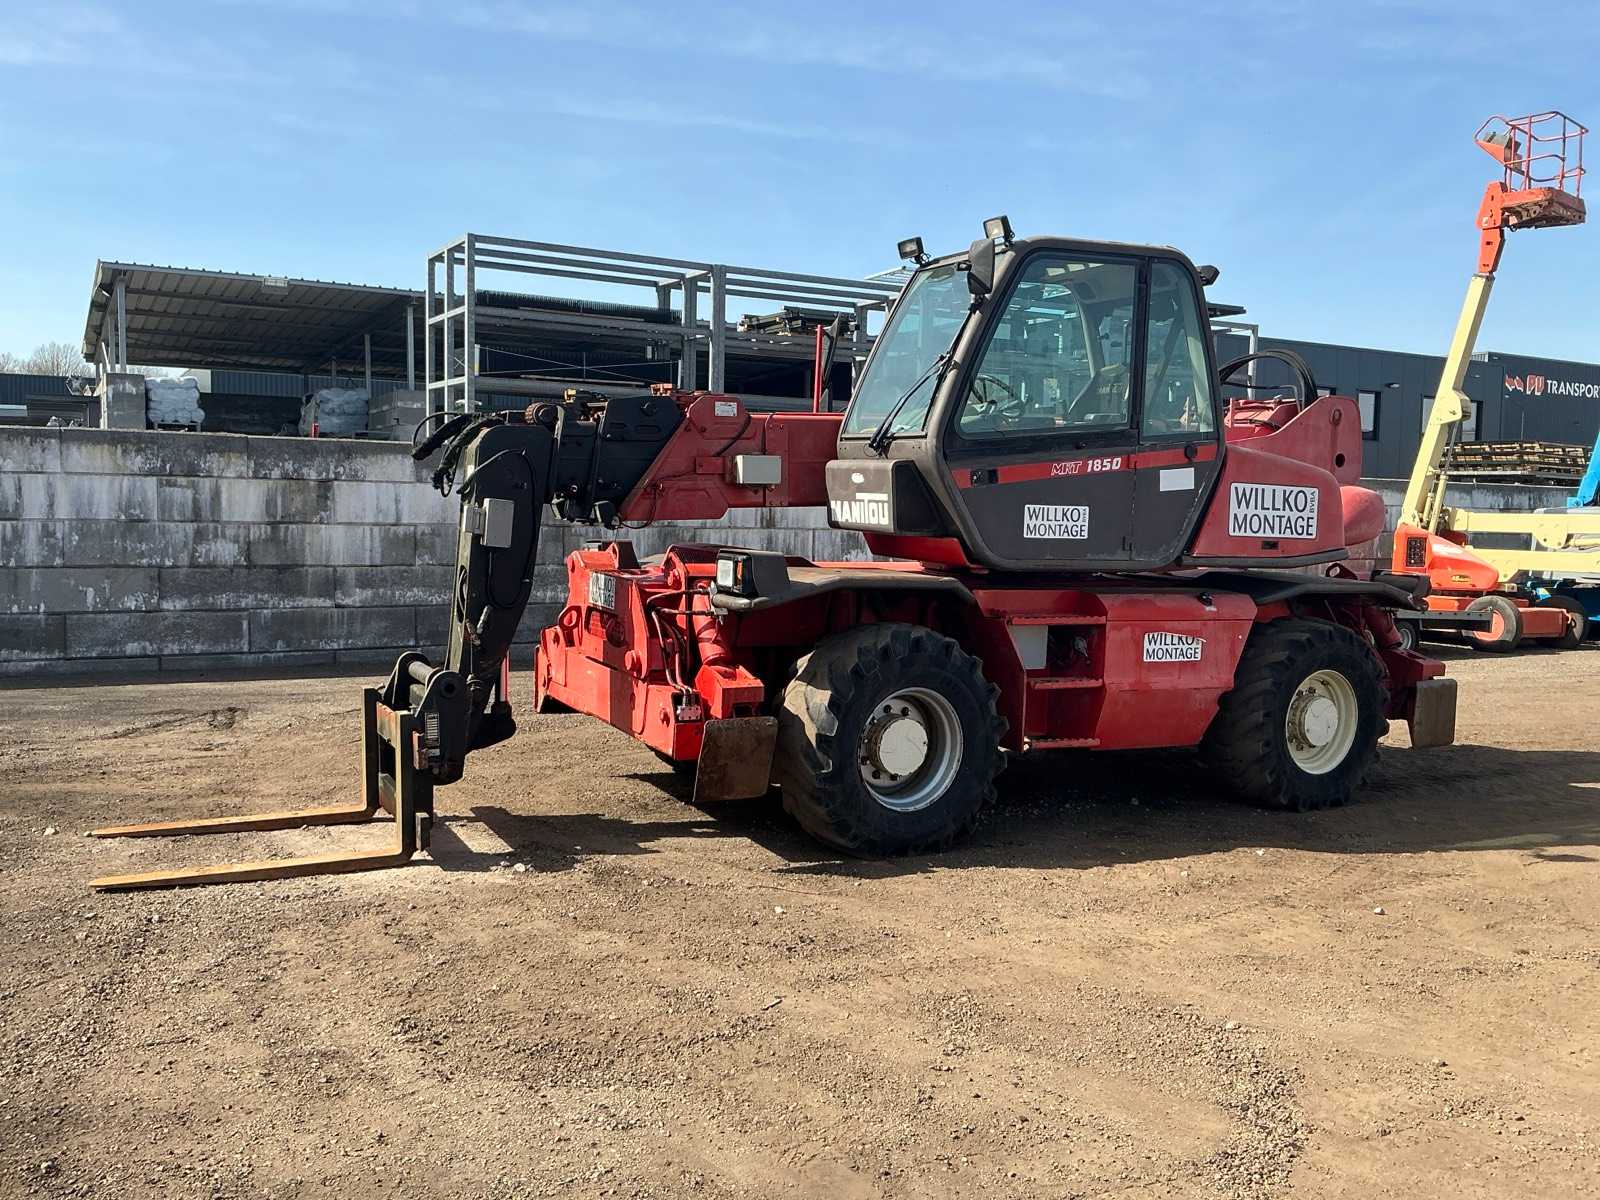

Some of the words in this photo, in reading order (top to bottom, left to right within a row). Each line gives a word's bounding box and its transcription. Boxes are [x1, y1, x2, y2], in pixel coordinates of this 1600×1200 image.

[1546, 379, 1600, 399] TRANSPOR
[1050, 461, 1082, 476] MRT
[1087, 457, 1122, 473] 1850
[1234, 486, 1308, 513] WILLKO
[1027, 506, 1081, 523] WILLKO
[1025, 523, 1087, 538] MONTAGE
[1232, 512, 1315, 537] MONTAGE
[1145, 646, 1200, 660] MONTAGE
